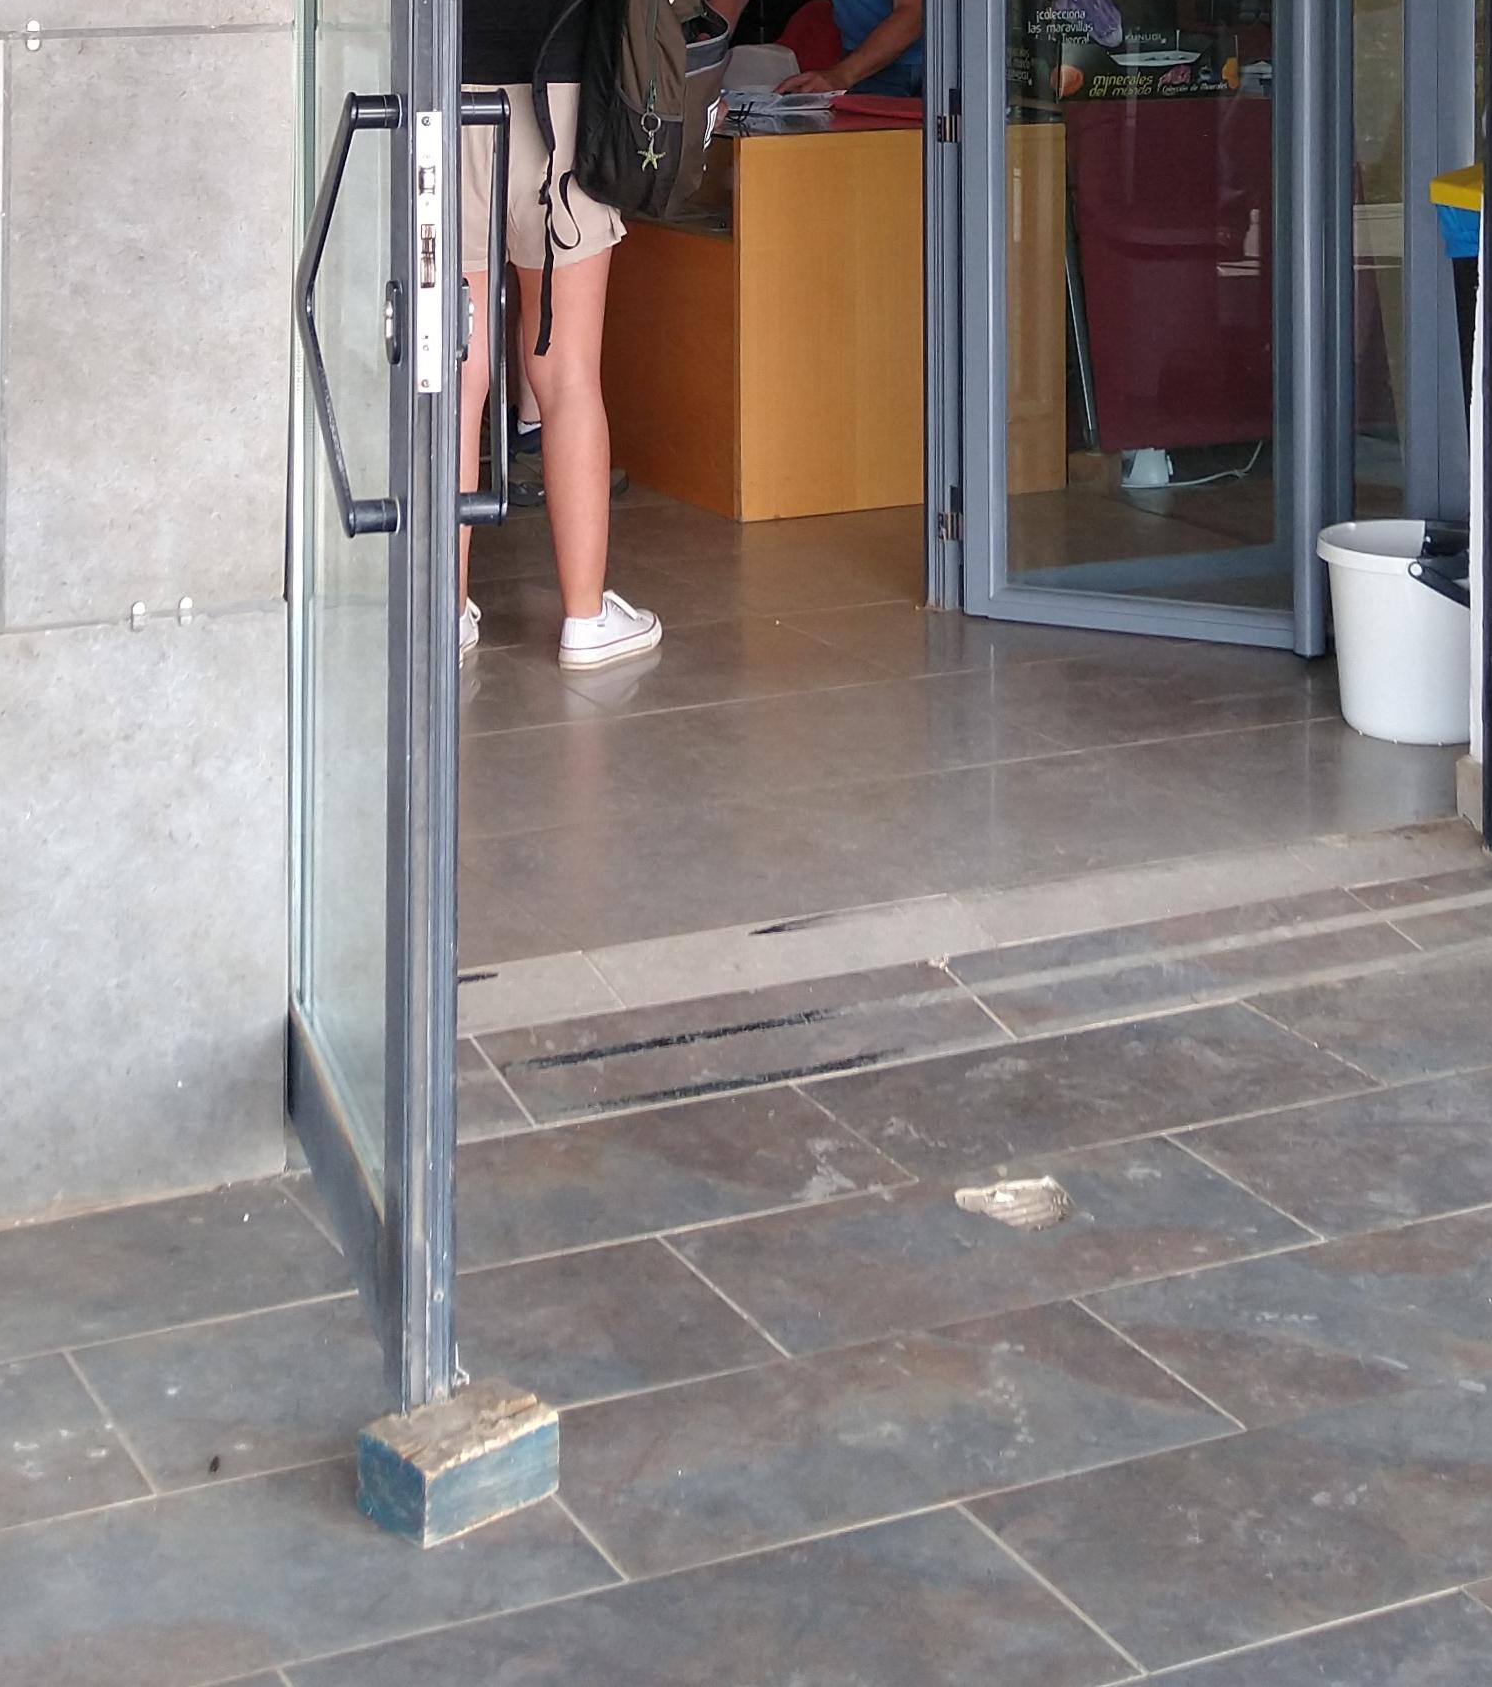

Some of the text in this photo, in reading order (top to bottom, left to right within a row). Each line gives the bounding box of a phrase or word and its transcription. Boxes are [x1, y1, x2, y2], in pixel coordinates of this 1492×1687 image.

[1028, 21, 1094, 34] las maravillas
[1093, 72, 1154, 88] minerales
[1089, 83, 1107, 97] del
